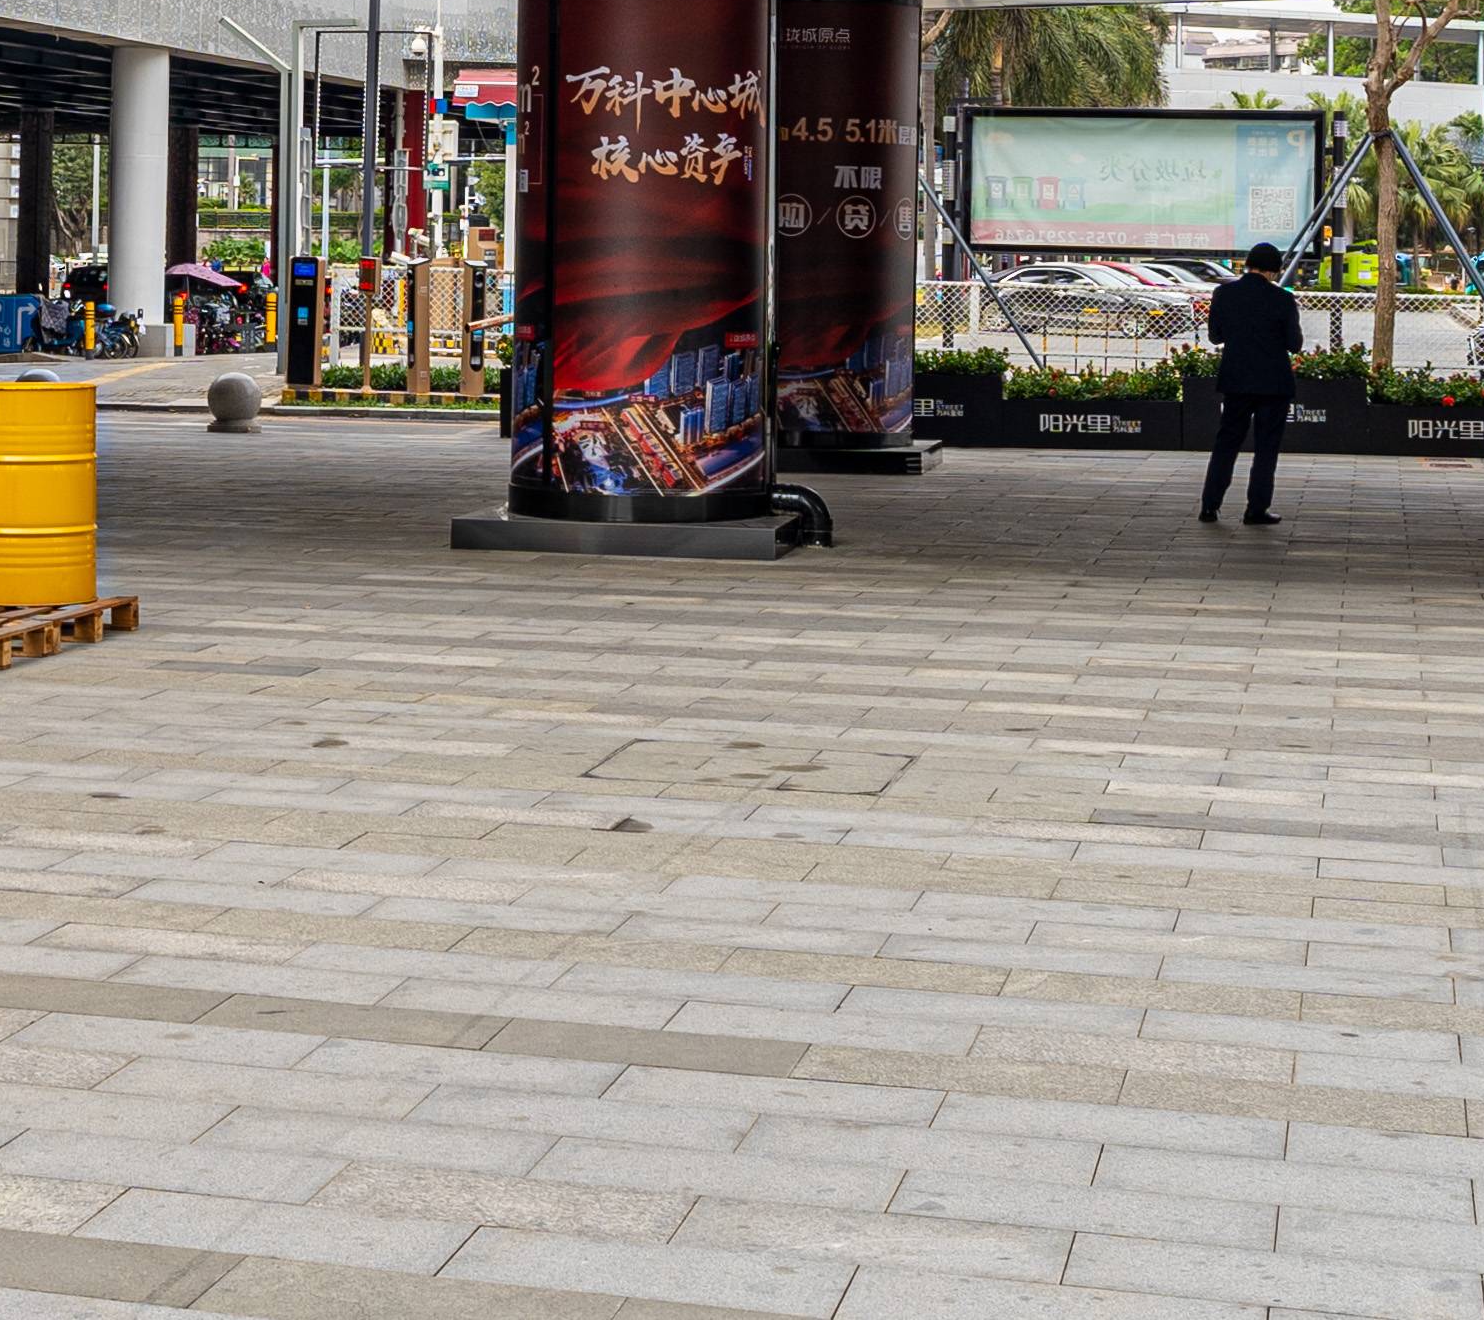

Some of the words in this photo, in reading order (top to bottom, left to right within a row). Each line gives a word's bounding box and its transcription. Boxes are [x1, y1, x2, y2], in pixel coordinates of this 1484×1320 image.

[786, 27, 852, 44] 珑城原点
[565, 64, 766, 134] 万科中心城
[590, 132, 743, 186] 核心资产
[833, 165, 883, 190] 不限
[1039, 413, 1111, 434] 阳光里
[1407, 419, 1484, 440] 阳光里
